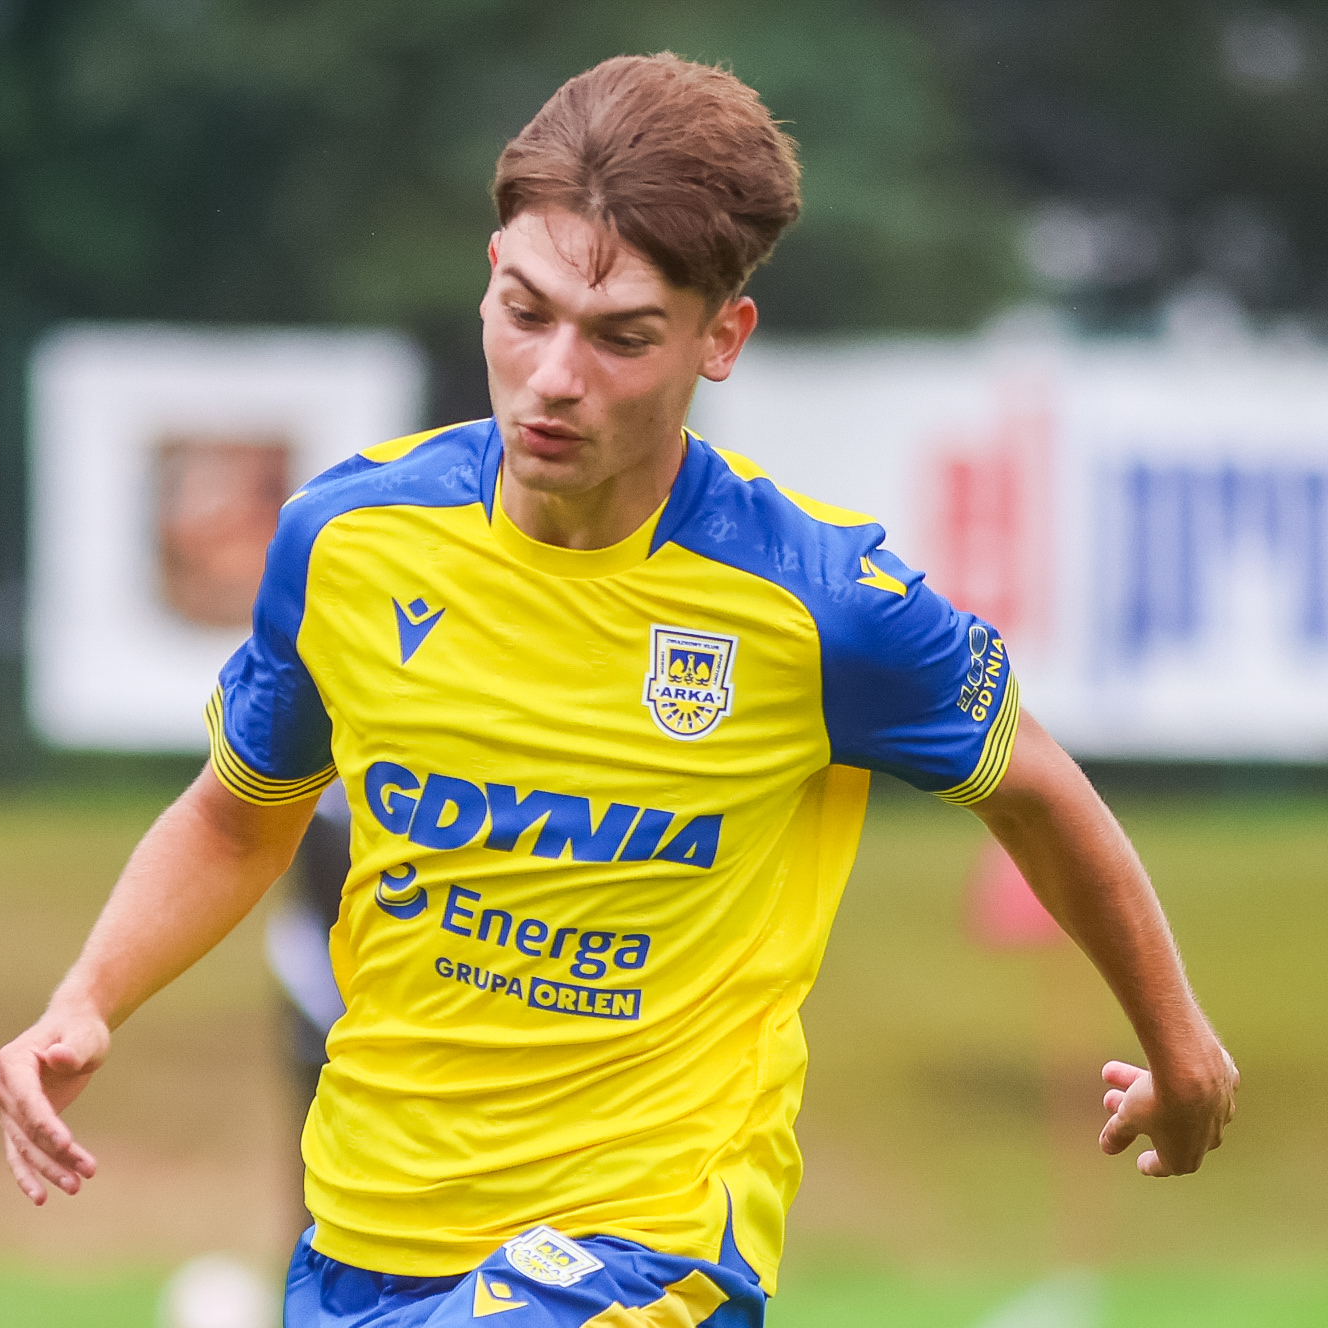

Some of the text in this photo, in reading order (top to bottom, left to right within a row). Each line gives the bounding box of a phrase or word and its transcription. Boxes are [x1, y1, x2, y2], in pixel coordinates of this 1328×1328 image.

[660, 687, 715, 704] ARKA
[971, 638, 1004, 722] GDYNIA
[364, 761, 724, 869] GDYNIA
[441, 884, 651, 980] Energa
[434, 957, 636, 1018] GRUPA ORLEN
